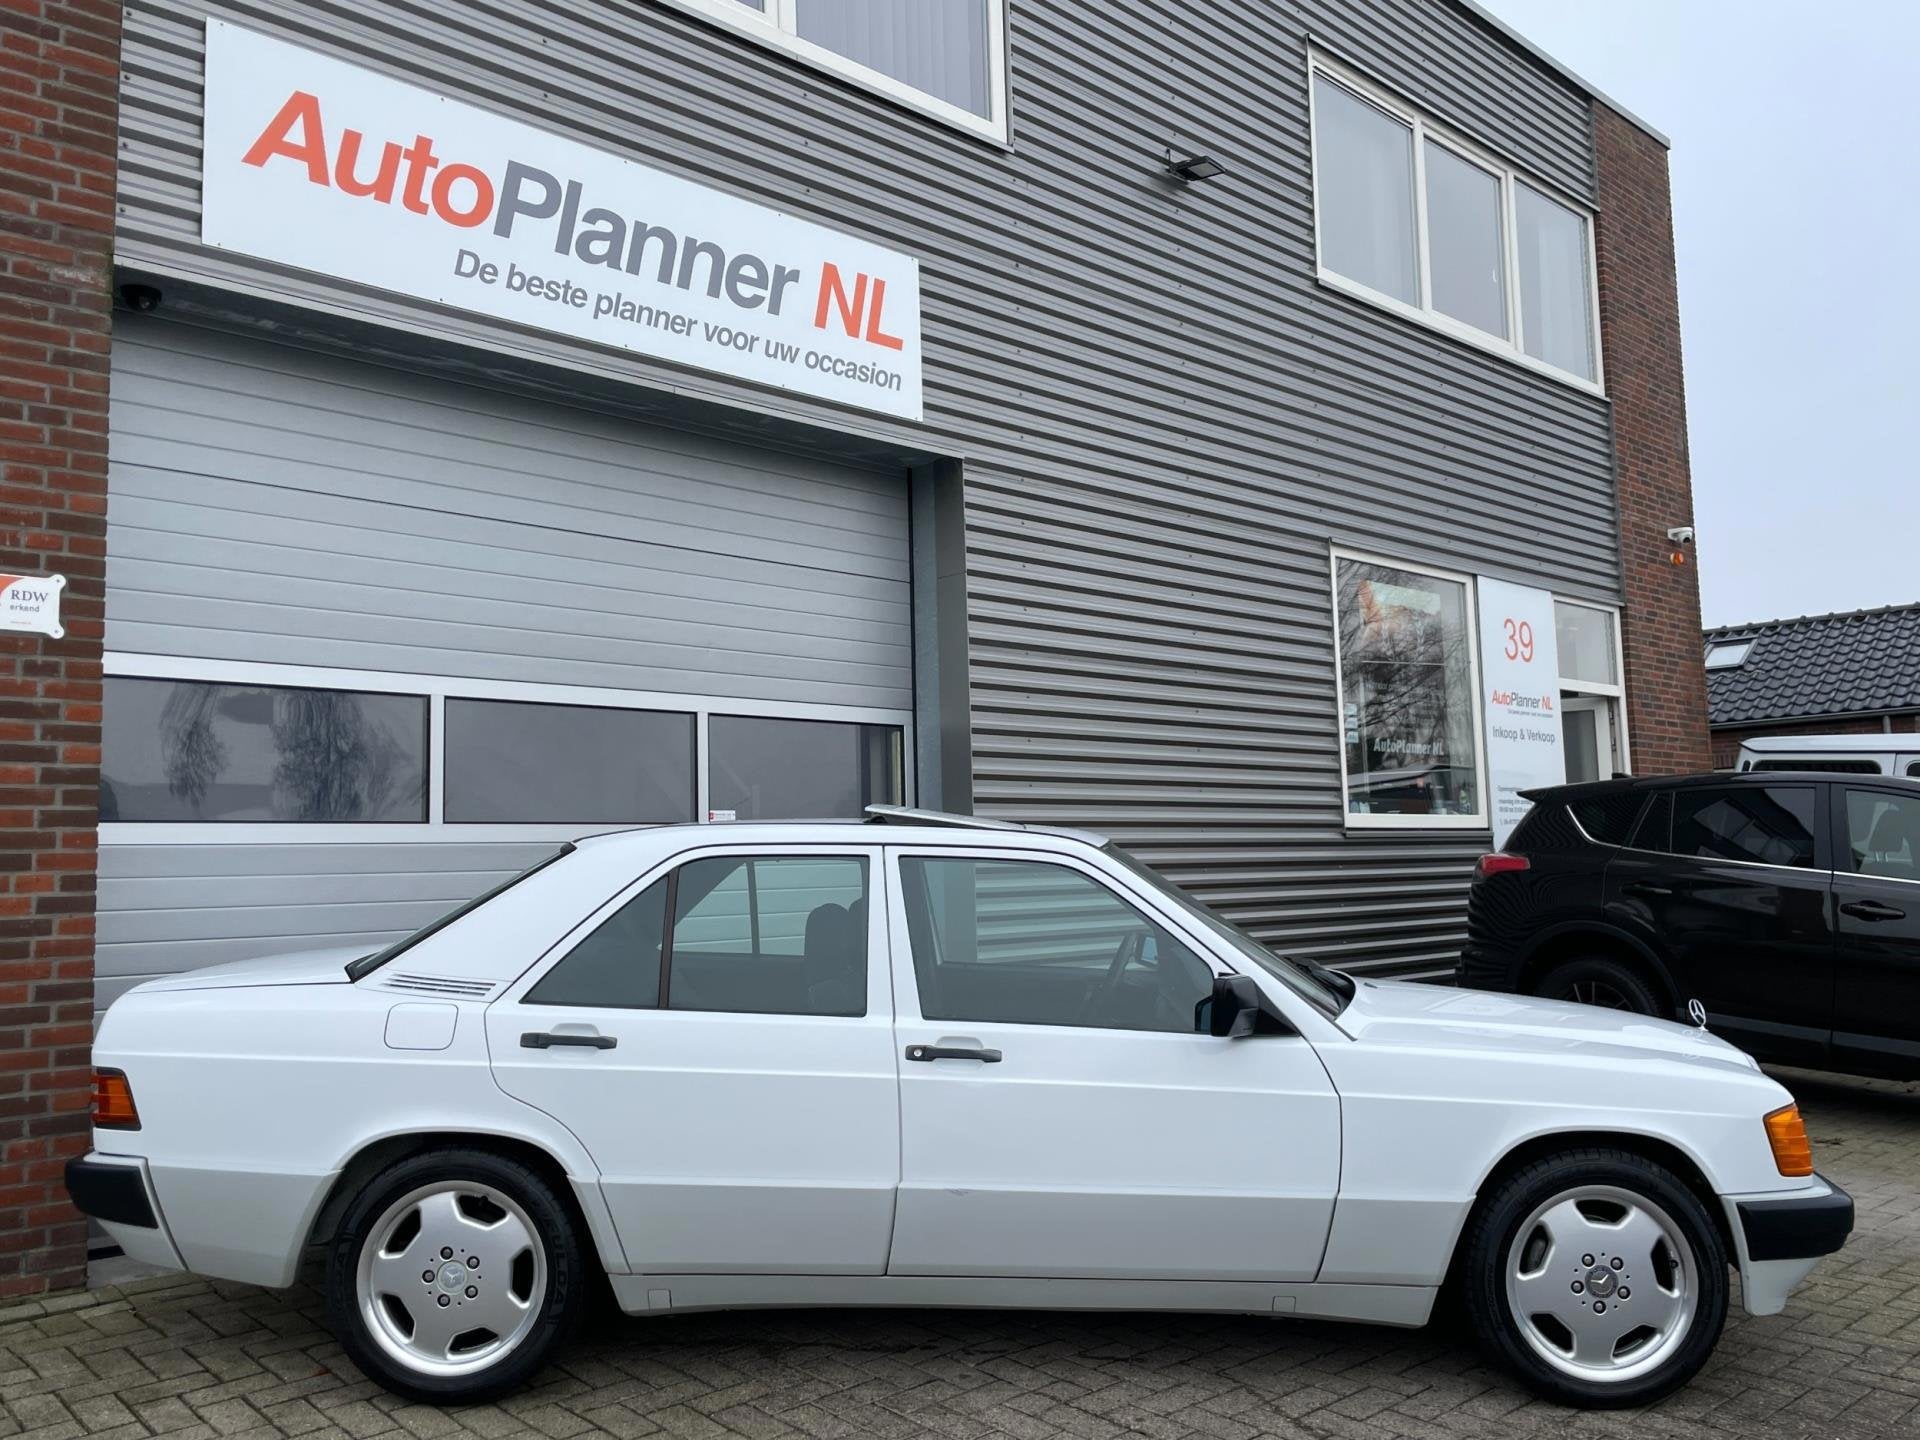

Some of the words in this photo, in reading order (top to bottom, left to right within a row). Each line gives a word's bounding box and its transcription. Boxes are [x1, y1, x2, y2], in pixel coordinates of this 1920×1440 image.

[241, 90, 801, 316] AutoPlanner
[814, 261, 904, 351] NL
[454, 248, 499, 285] De
[505, 262, 588, 308] beste
[593, 292, 698, 337] planner
[704, 322, 760, 353] voor
[764, 339, 801, 364] uw
[804, 350, 902, 391] occasion
[10, 589, 49, 603] RDW
[10, 603, 40, 613] erkend
[1503, 618, 1533, 662] 39
[1492, 689, 1540, 709] AutoPlanner
[1541, 695, 1553, 710] NL
[1493, 726, 1518, 742] Inkoop
[1519, 728, 1526, 740] &
[1527, 729, 1556, 746] Verkoop
[1374, 738, 1431, 755] AutoPlanner
[1432, 741, 1445, 756] NL
